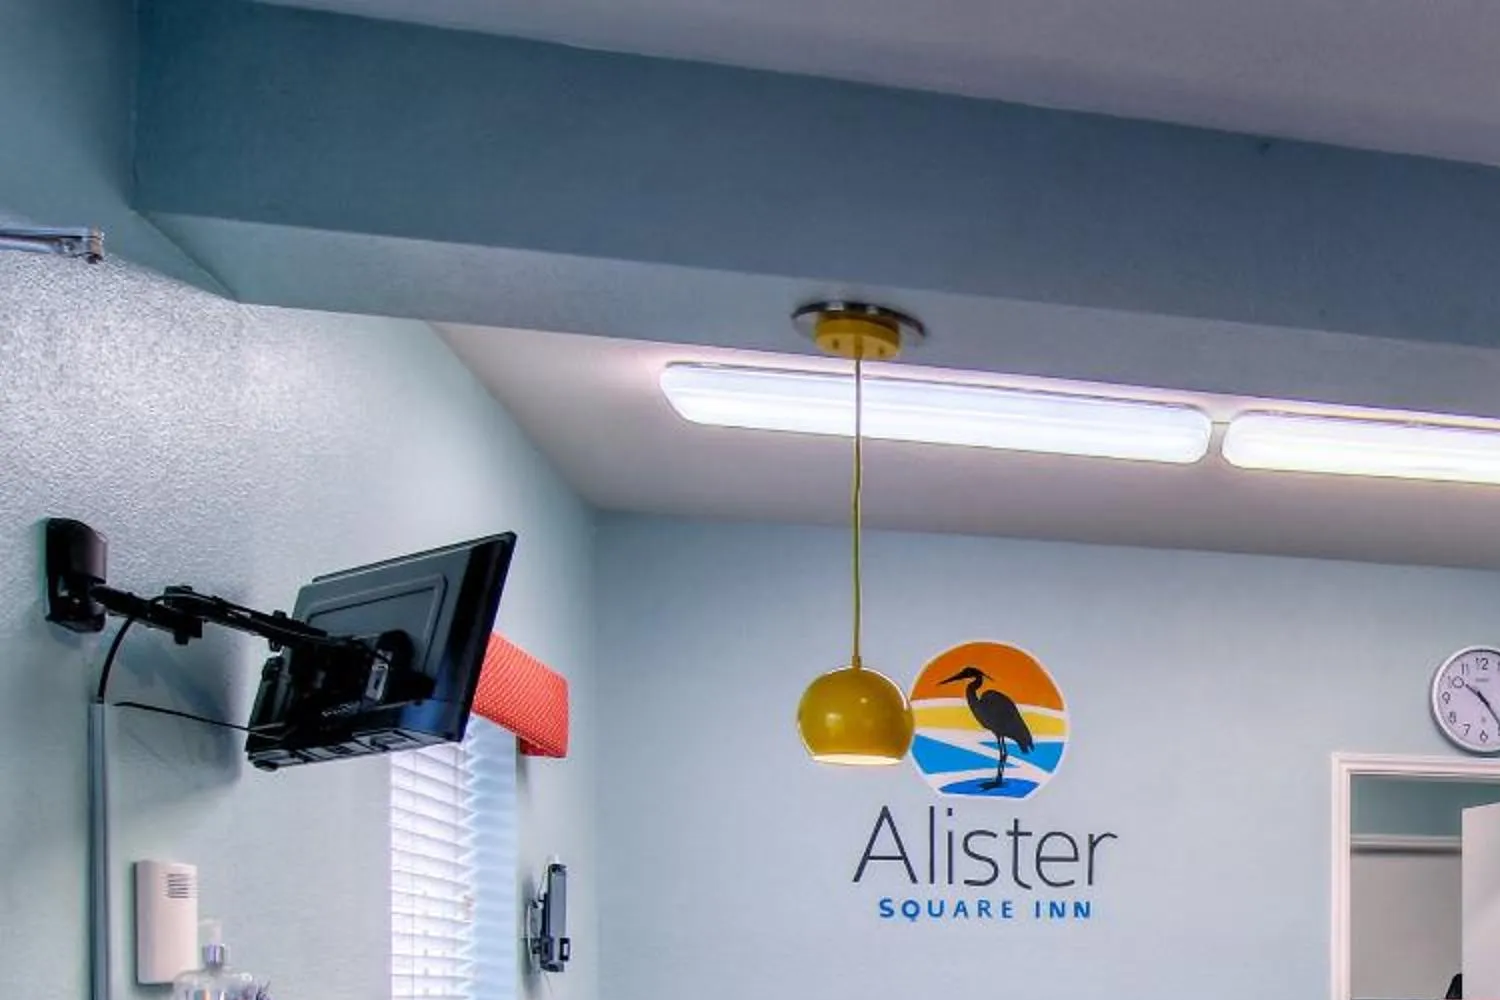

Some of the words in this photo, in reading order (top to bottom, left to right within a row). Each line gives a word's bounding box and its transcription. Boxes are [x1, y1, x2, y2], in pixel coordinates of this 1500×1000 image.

[1461, 663, 1470, 675] 11
[1475, 657, 1489, 671] 12
[1447, 675, 1465, 689] 10
[1441, 691, 1451, 705] 9
[1448, 711, 1457, 724] 8
[1462, 723, 1471, 736] 7
[1479, 729, 1489, 743] 6
[851, 805, 1119, 890] Alister
[879, 898, 1013, 922] SQUARE
[1035, 900, 1091, 919] INN
